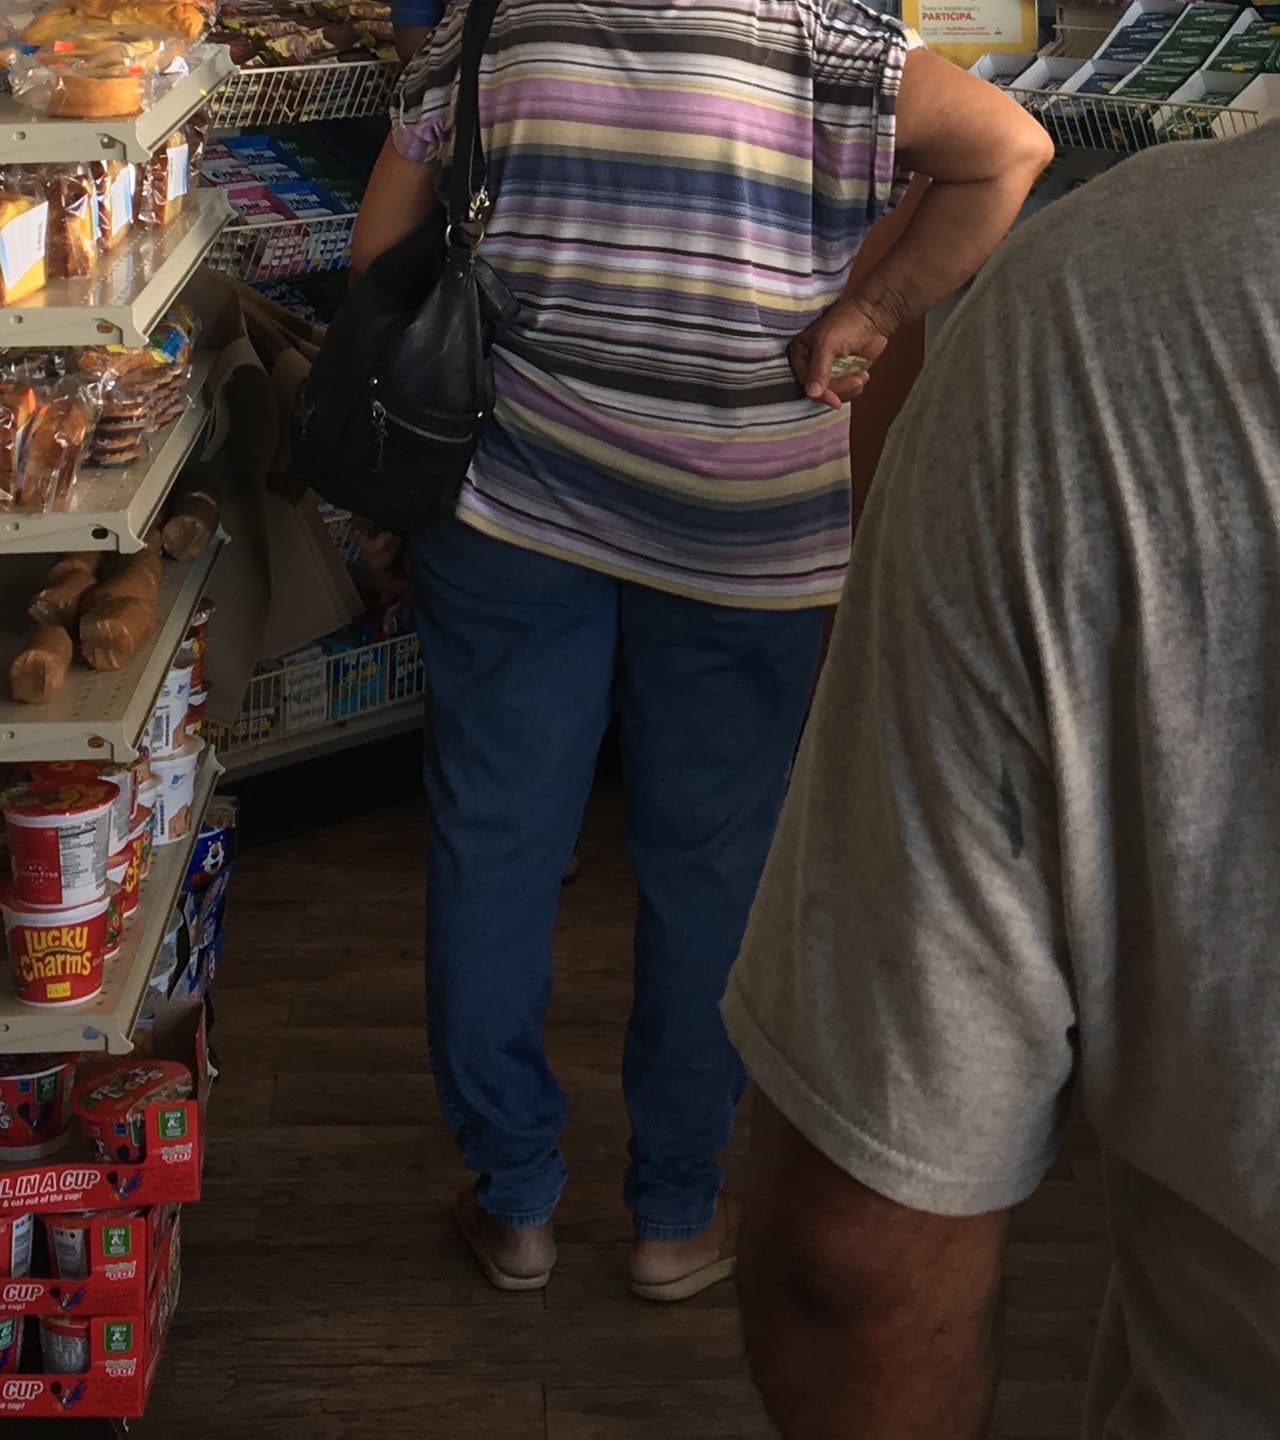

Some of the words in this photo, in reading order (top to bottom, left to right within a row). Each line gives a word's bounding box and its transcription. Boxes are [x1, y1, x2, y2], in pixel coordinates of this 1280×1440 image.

[921, 12, 976, 21] PARTICIPA.
[23, 926, 89, 958] Lucky
[20, 951, 93, 982] Charms
[14, 1176, 37, 1197] IN
[36, 1173, 57, 1194] A
[59, 1170, 101, 1190] CUP
[10, 1199, 24, 1208] eat
[24, 1197, 39, 1207] out
[39, 1196, 48, 1205] of
[48, 1195, 62, 1204] the
[62, 1192, 83, 1204] cup!
[3, 1283, 45, 1302] CUP
[6, 1302, 26, 1313] cup!
[3, 1380, 45, 1400] CUP
